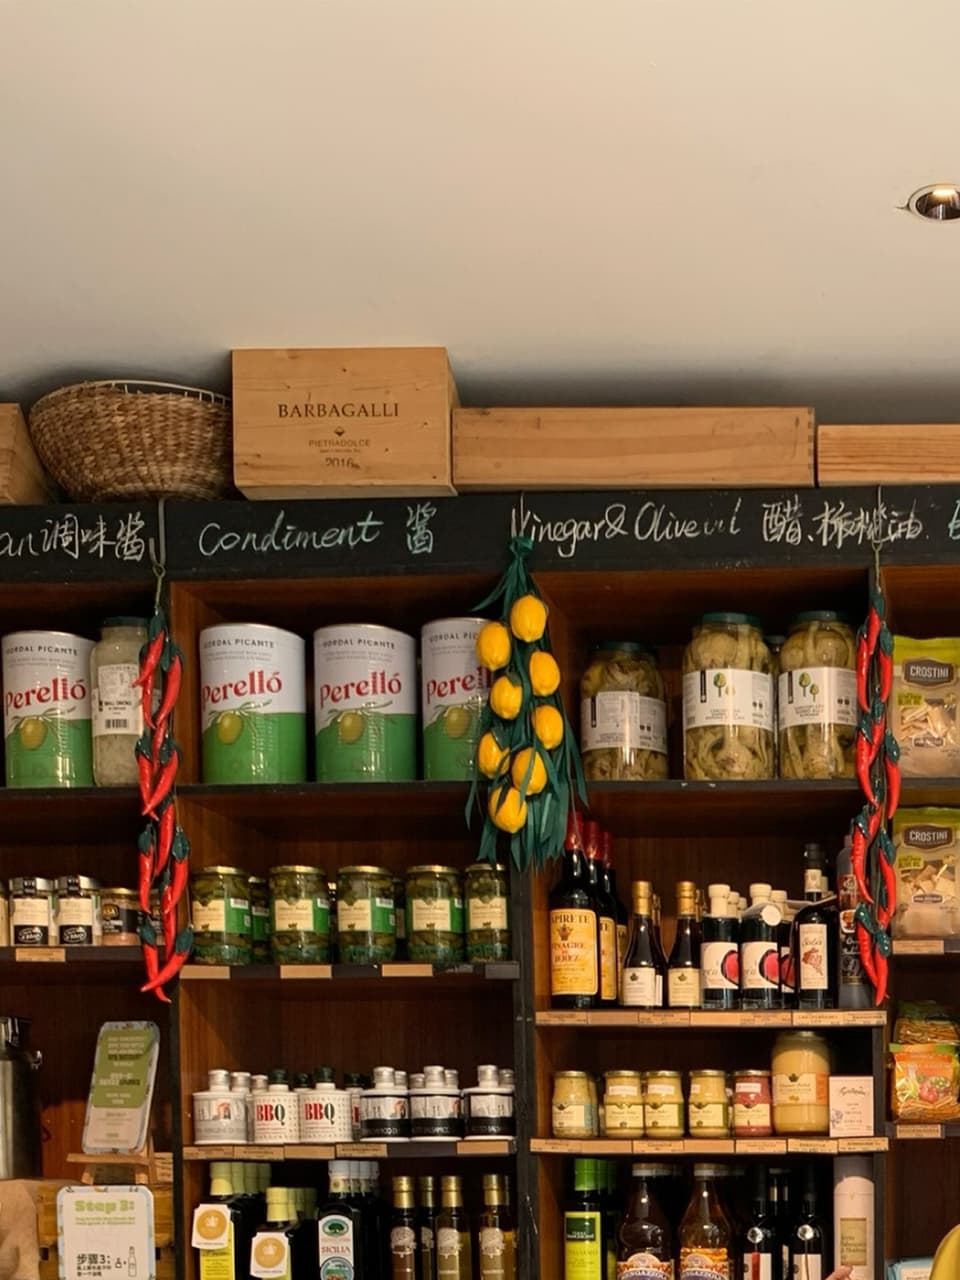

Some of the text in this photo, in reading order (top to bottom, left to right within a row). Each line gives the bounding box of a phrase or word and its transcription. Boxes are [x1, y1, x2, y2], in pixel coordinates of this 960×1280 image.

[278, 403, 399, 418] BARBAGALLI
[199, 510, 384, 557] Condiment
[909, 665, 949, 679] CROSTINI
[909, 830, 948, 842] CROSTINI
[255, 1103, 285, 1126] BBQ
[304, 1102, 335, 1125] BBQ
[75, 1199, 117, 1214] Step
